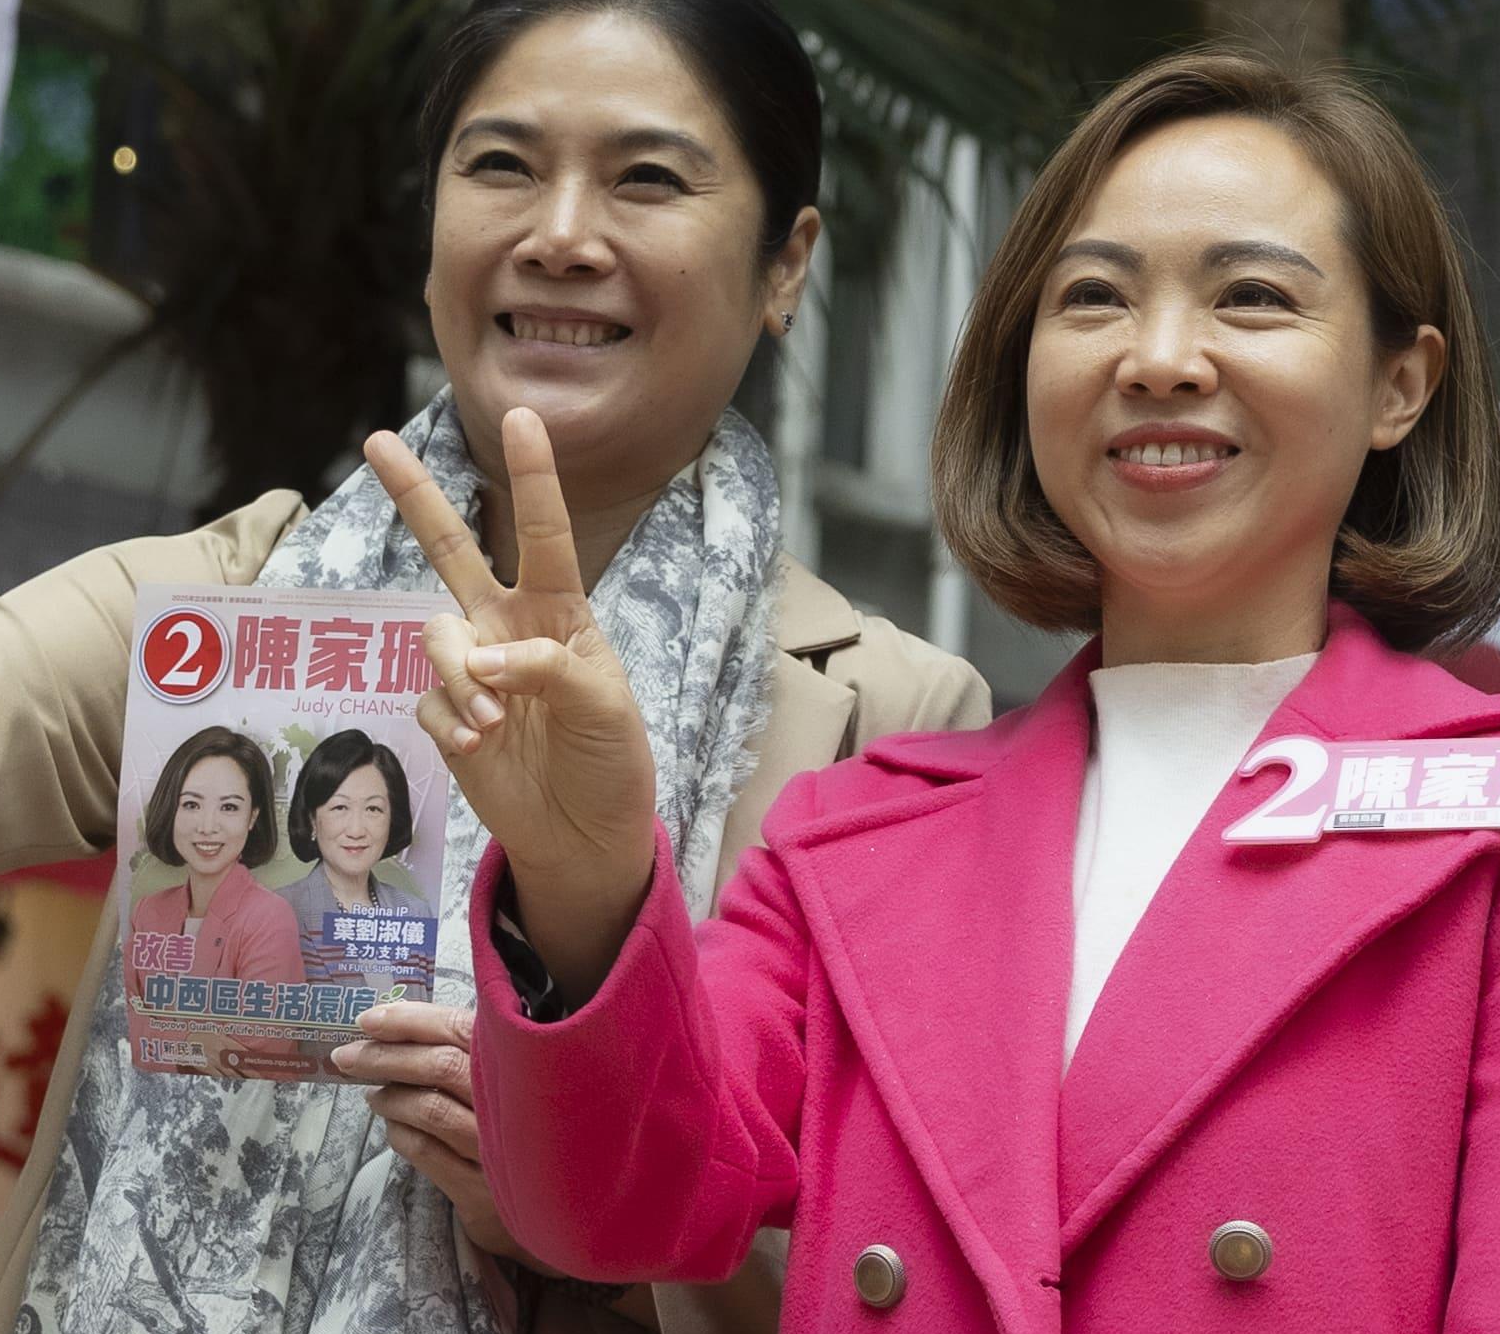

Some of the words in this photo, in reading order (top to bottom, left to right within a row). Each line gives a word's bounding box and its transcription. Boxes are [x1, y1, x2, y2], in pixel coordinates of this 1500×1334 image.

[159, 620, 204, 687] 2
[232, 615, 444, 695] 陳家珮
[291, 696, 335, 718] Judy
[339, 697, 395, 716] CHAN
[1222, 737, 1329, 845] 2
[353, 903, 393, 918] Regina
[396, 906, 409, 917] IP
[333, 917, 426, 946] 葉劉淑儀
[132, 931, 197, 974] 改善
[345, 942, 411, 961] 全力支持
[338, 963, 348, 972] IN
[349, 963, 370, 973] FULL
[372, 964, 416, 975] SUPPORT
[144, 972, 379, 1025] 中西區生活環境
[151, 1018, 187, 1032] Improve
[189, 1021, 222, 1035] Quality
[223, 1023, 234, 1034] of
[235, 1024, 253, 1036] Life
[255, 1026, 265, 1037] in
[266, 1027, 283, 1038] the
[284, 1027, 319, 1041] Central
[319, 1030, 338, 1043] and
